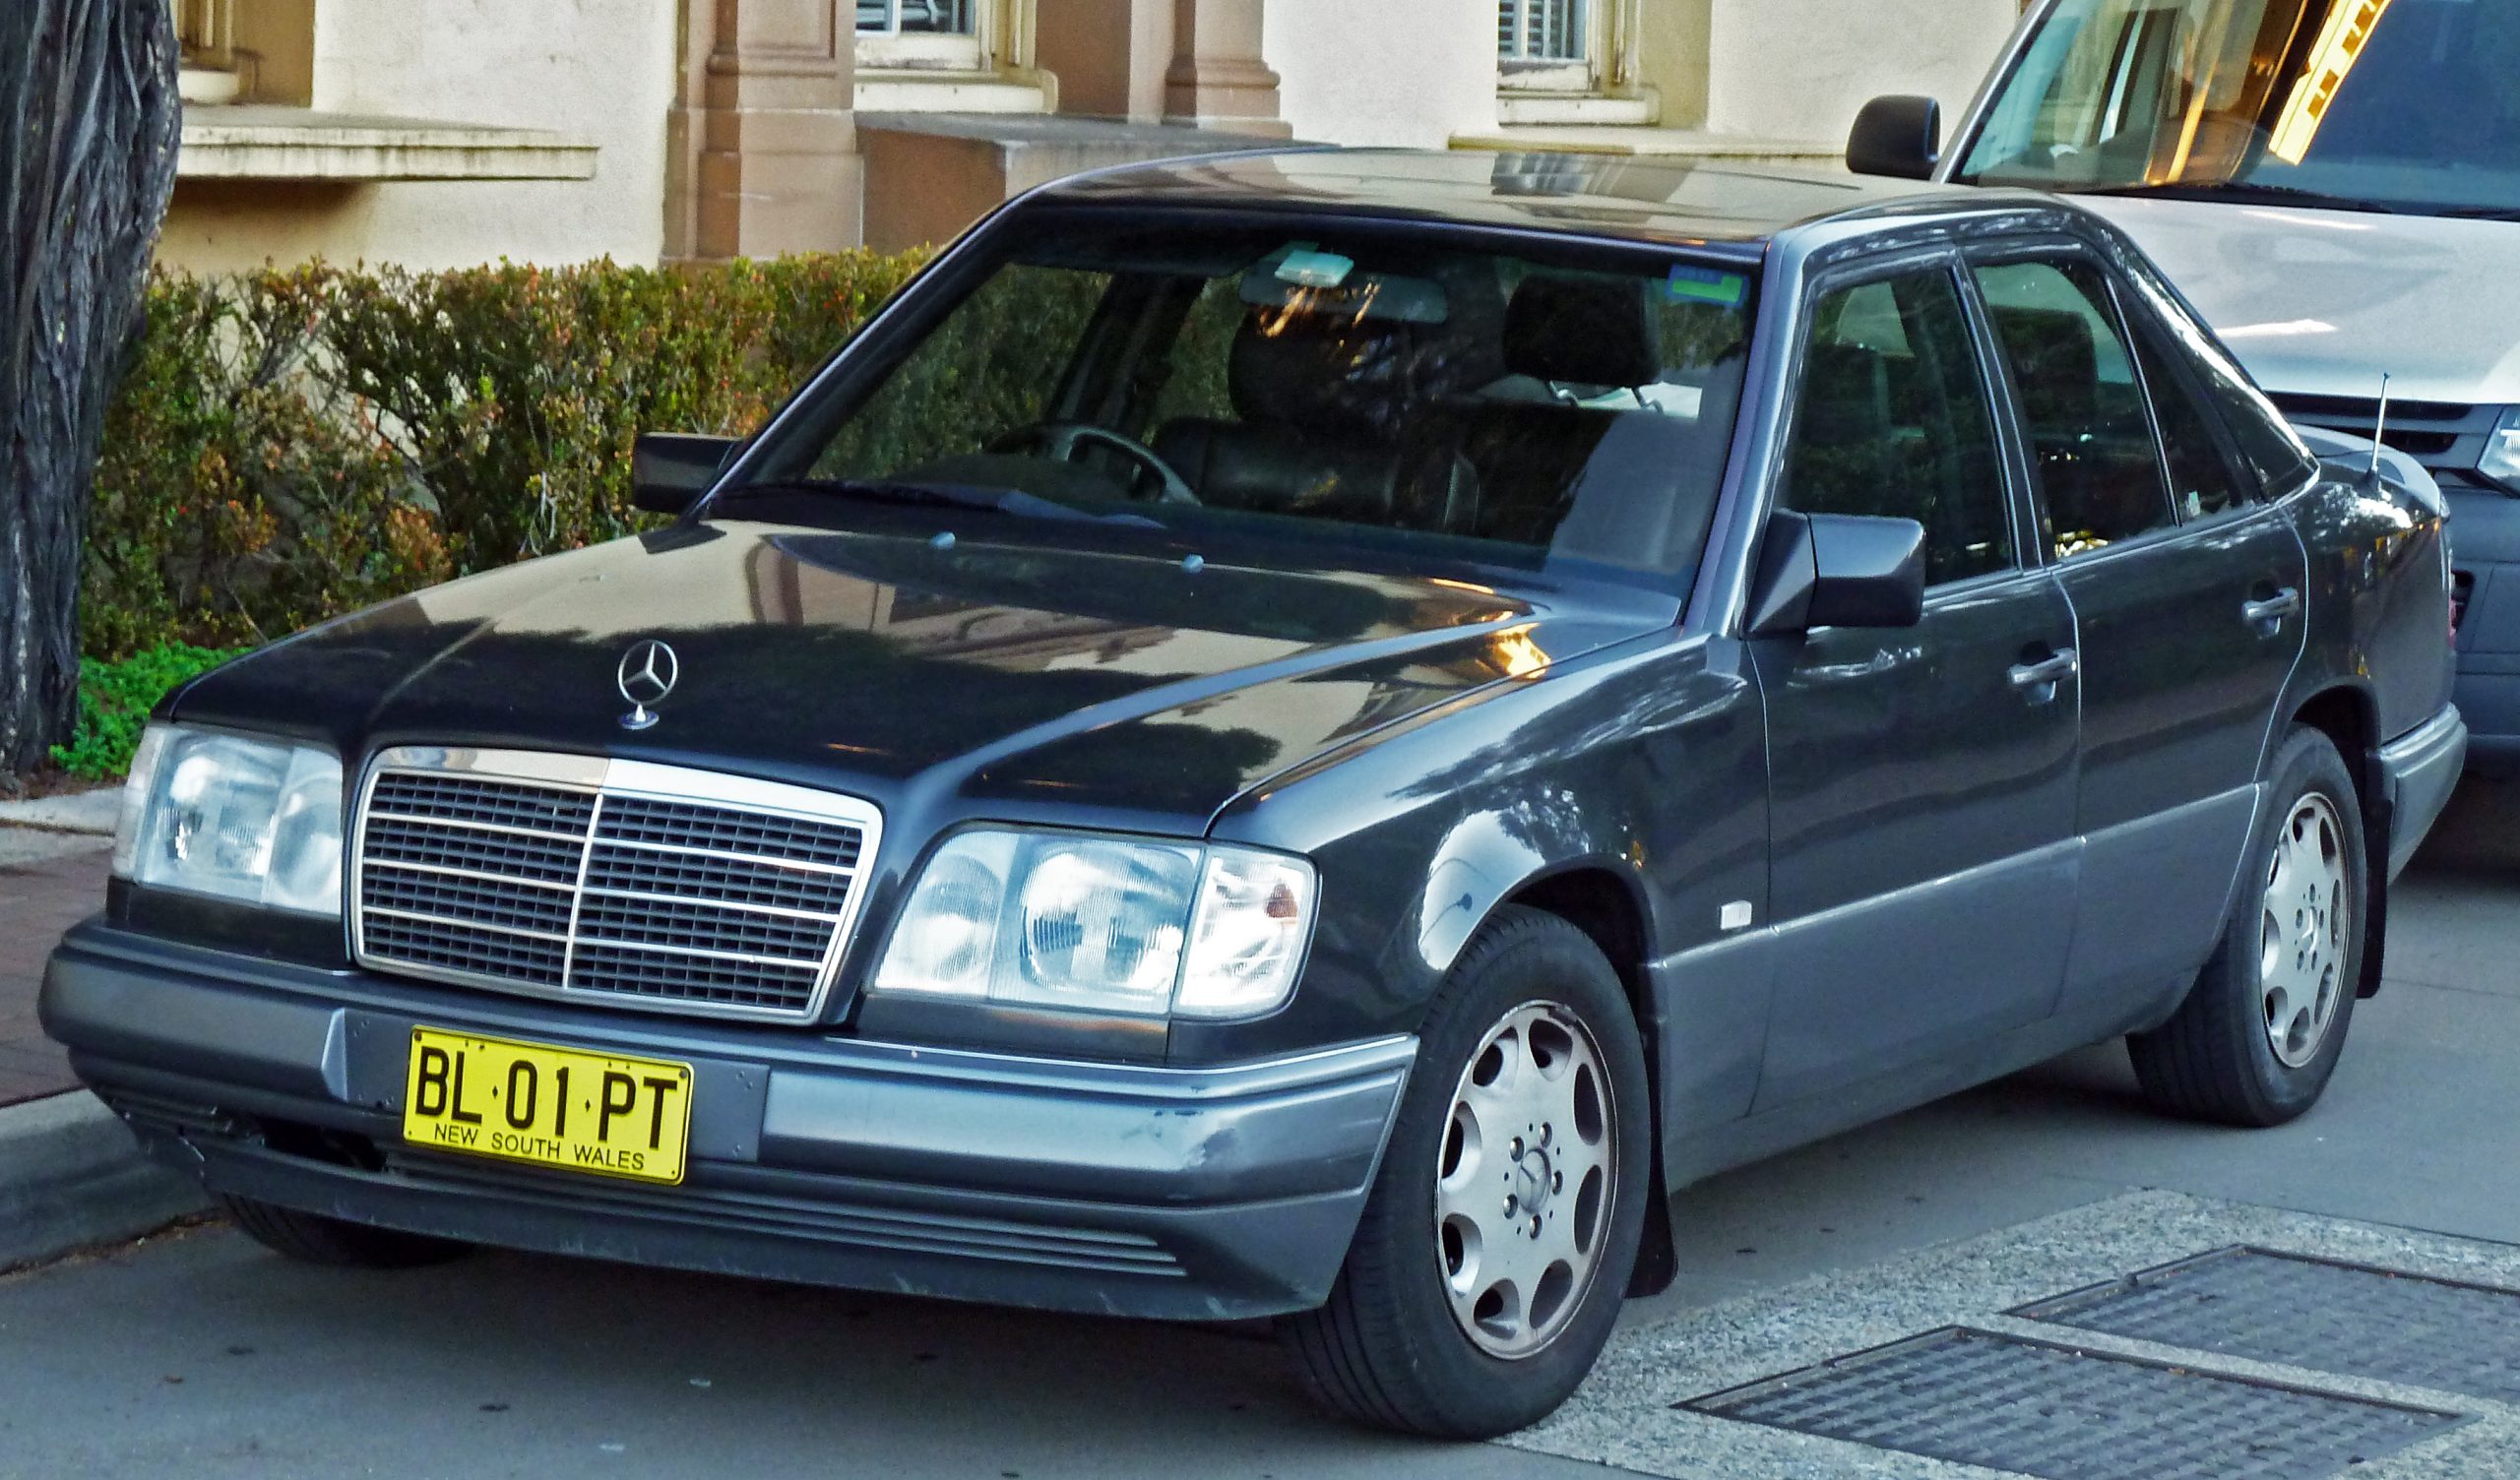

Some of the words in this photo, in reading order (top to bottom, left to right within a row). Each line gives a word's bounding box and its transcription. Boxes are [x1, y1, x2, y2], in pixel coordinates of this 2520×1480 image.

[433, 1122, 479, 1146] NEW
[490, 1131, 561, 1160] SOUTH
[573, 1142, 645, 1171] WALES
